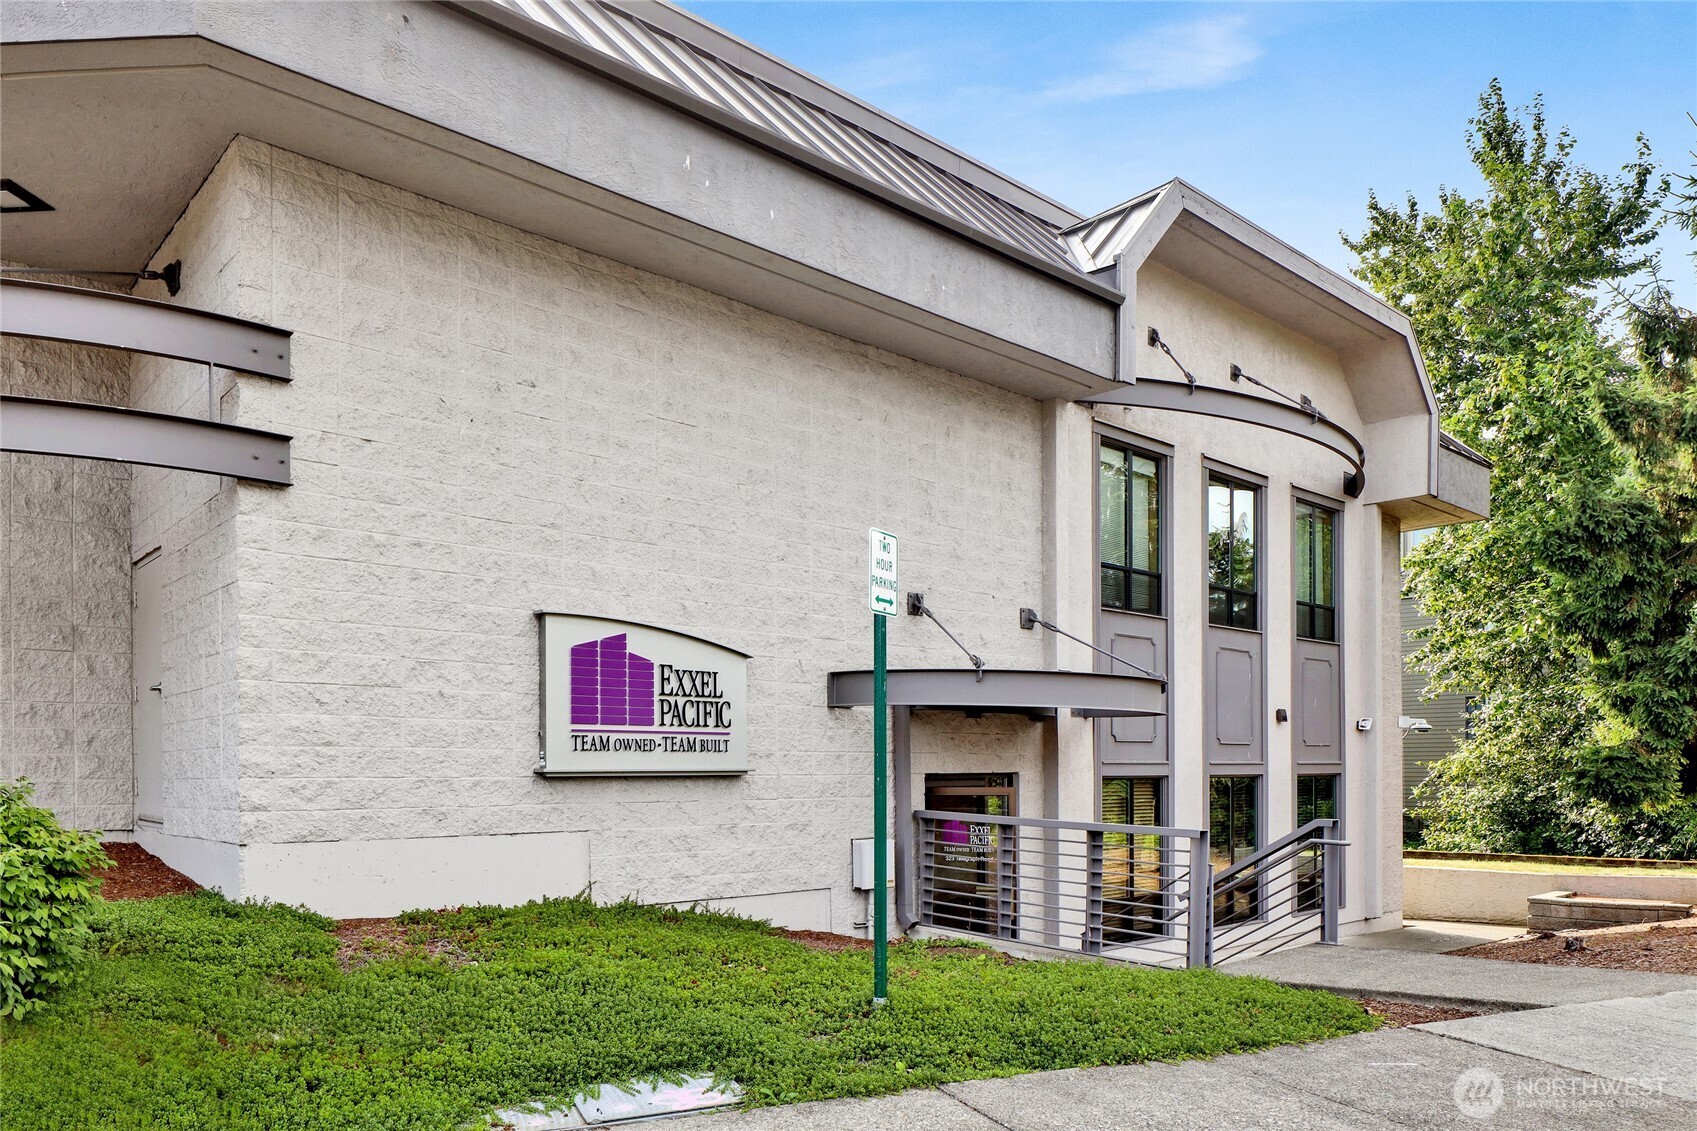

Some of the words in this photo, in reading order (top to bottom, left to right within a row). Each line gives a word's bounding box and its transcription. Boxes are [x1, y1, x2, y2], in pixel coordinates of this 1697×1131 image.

[879, 540, 890, 554] TWO
[876, 558, 892, 572] HOUR
[871, 575, 897, 592] PARKING
[659, 664, 723, 698] EXXEL
[659, 699, 732, 728] PACIFIC
[571, 735, 611, 752] TEAM
[700, 739, 730, 753] BUILT
[970, 835, 995, 845] PACIFIC
